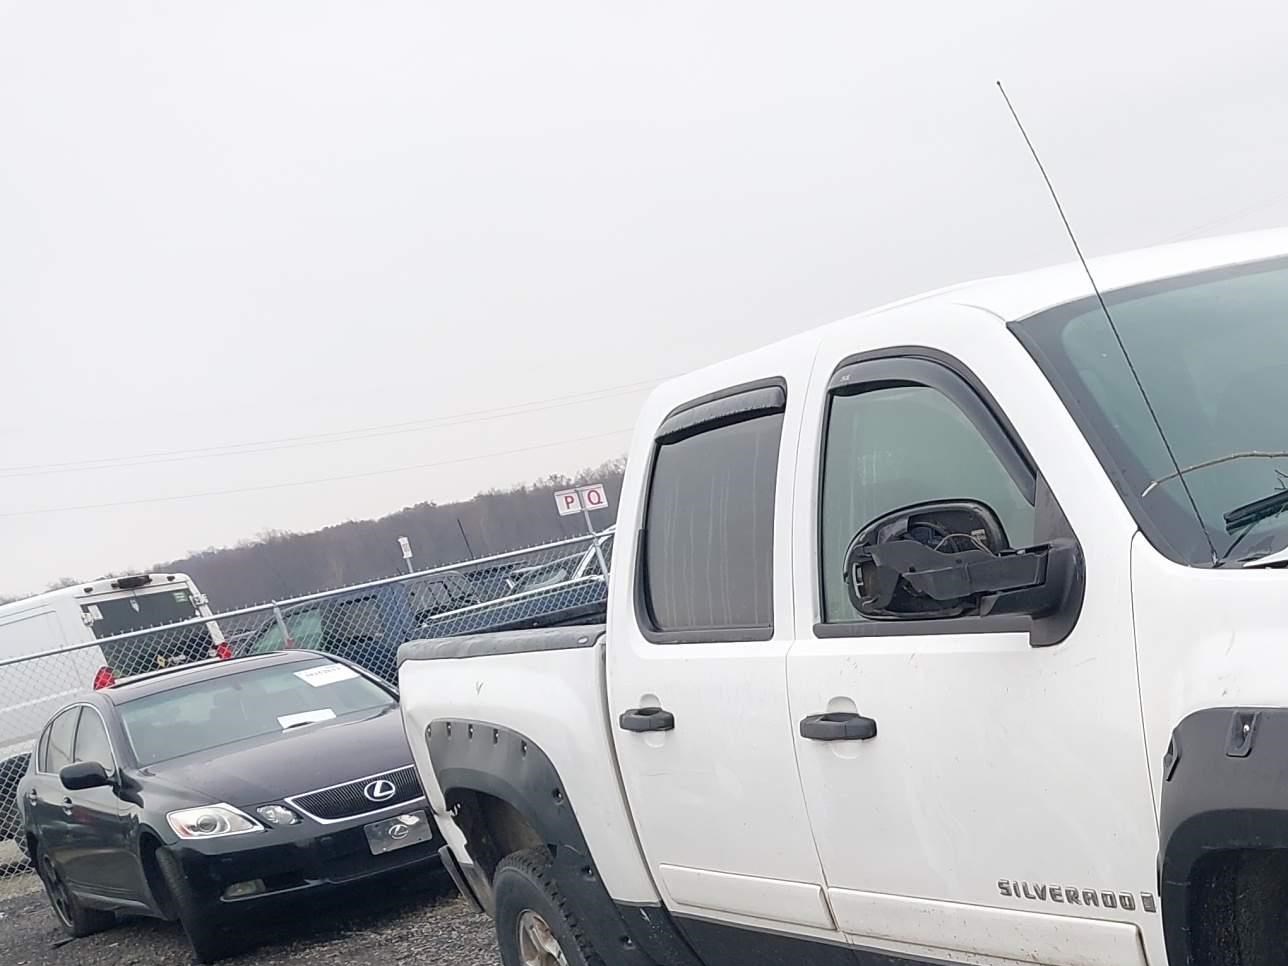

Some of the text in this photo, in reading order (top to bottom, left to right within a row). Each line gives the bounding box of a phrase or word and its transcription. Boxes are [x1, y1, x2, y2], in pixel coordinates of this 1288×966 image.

[564, 495, 575, 510] P
[587, 489, 603, 506] Q
[997, 879, 1136, 911] SILVERADO
